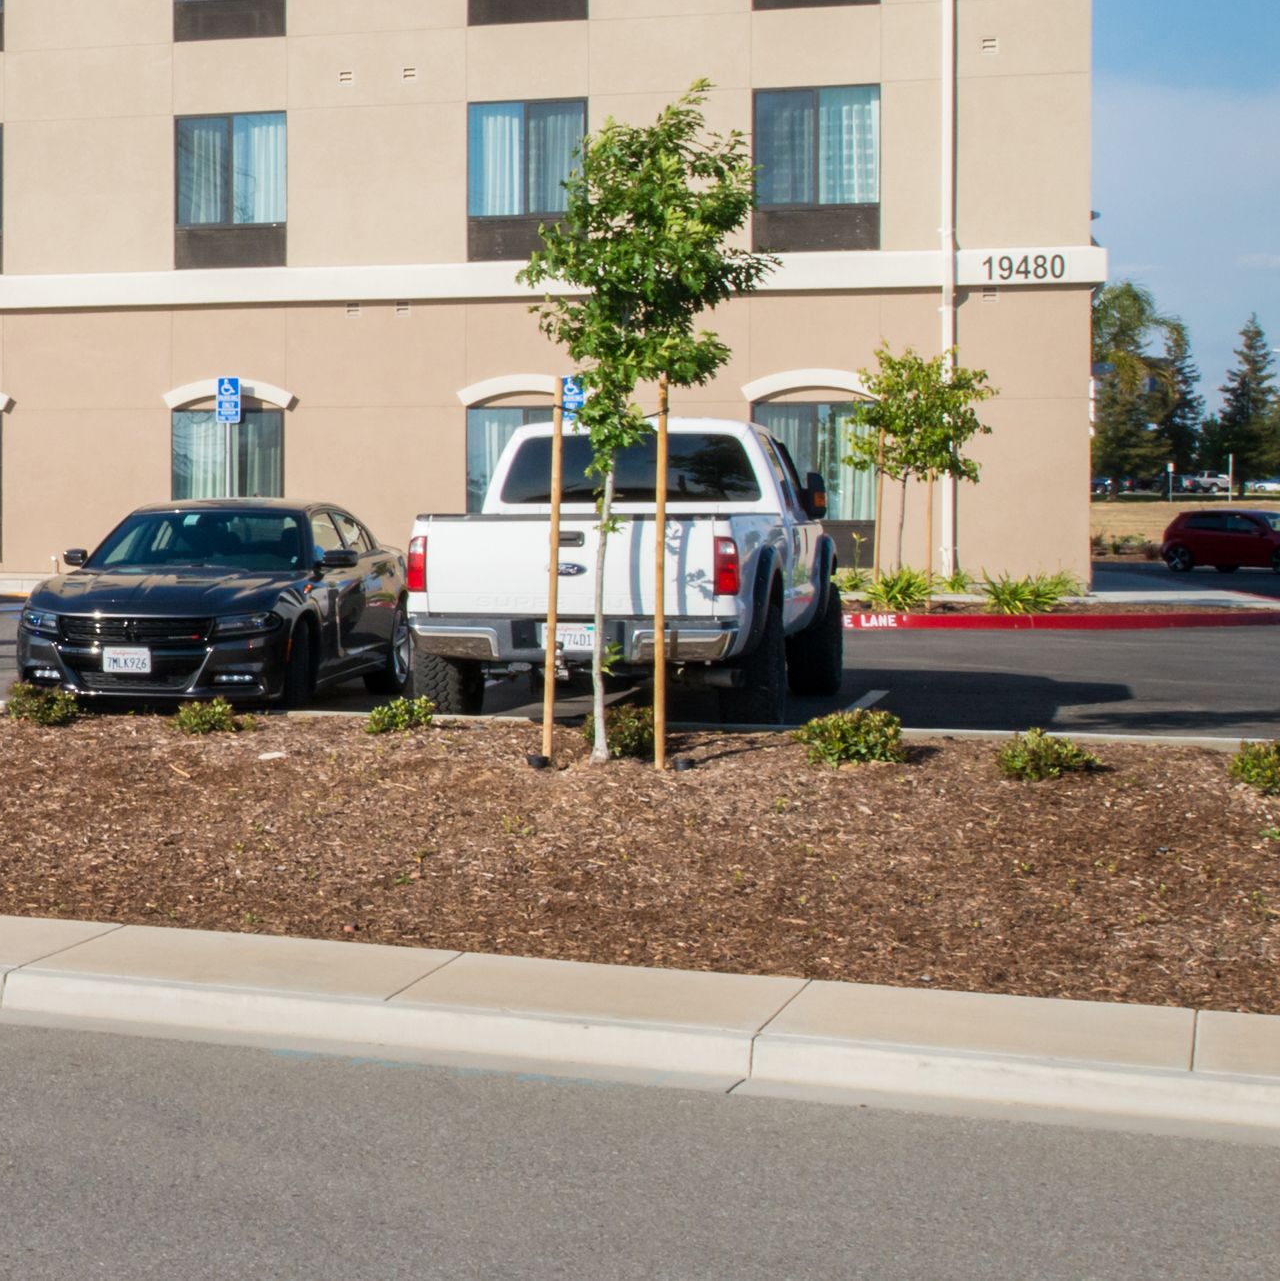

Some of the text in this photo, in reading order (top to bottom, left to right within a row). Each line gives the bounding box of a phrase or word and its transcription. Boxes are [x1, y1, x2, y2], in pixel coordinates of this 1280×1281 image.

[982, 254, 1066, 281] 19480
[861, 614, 898, 627] LANE
[106, 656, 148, 671] 7MLK926
